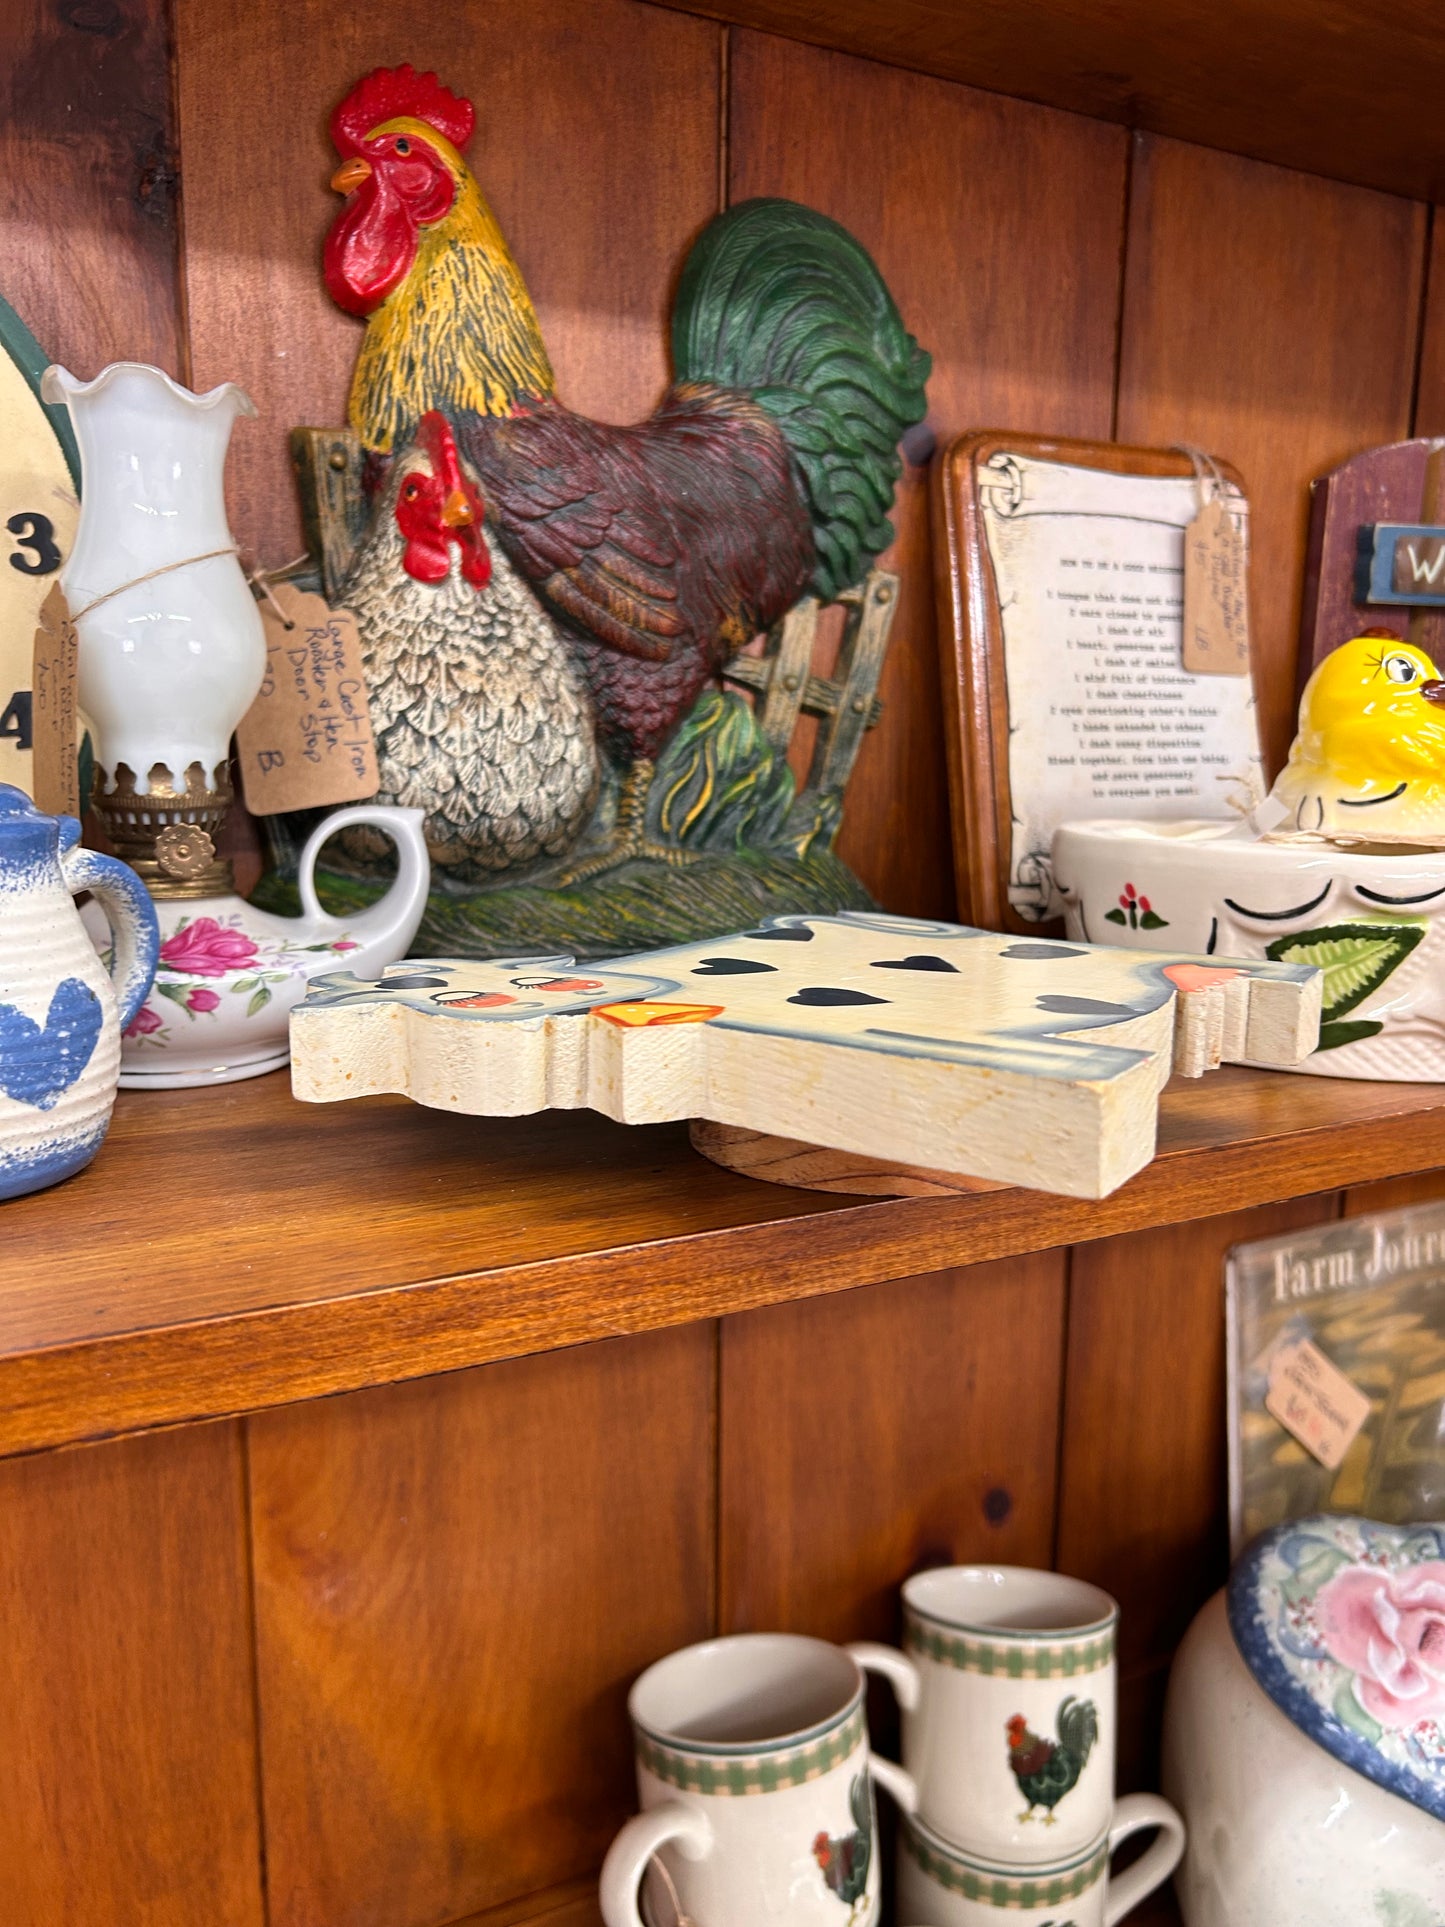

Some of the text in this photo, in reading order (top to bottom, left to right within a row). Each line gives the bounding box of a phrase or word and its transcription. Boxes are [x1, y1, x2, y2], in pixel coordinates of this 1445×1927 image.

[7, 512, 62, 576] 3
[1407, 543, 1445, 584] W
[0, 691, 34, 751] 4
[287, 649, 322, 763] Door Stop
[304, 628, 332, 693] Rooster
[319, 716, 343, 755] Hen
[321, 618, 369, 780] Large Cast Iron
[1273, 1247, 1355, 1301] Farm
